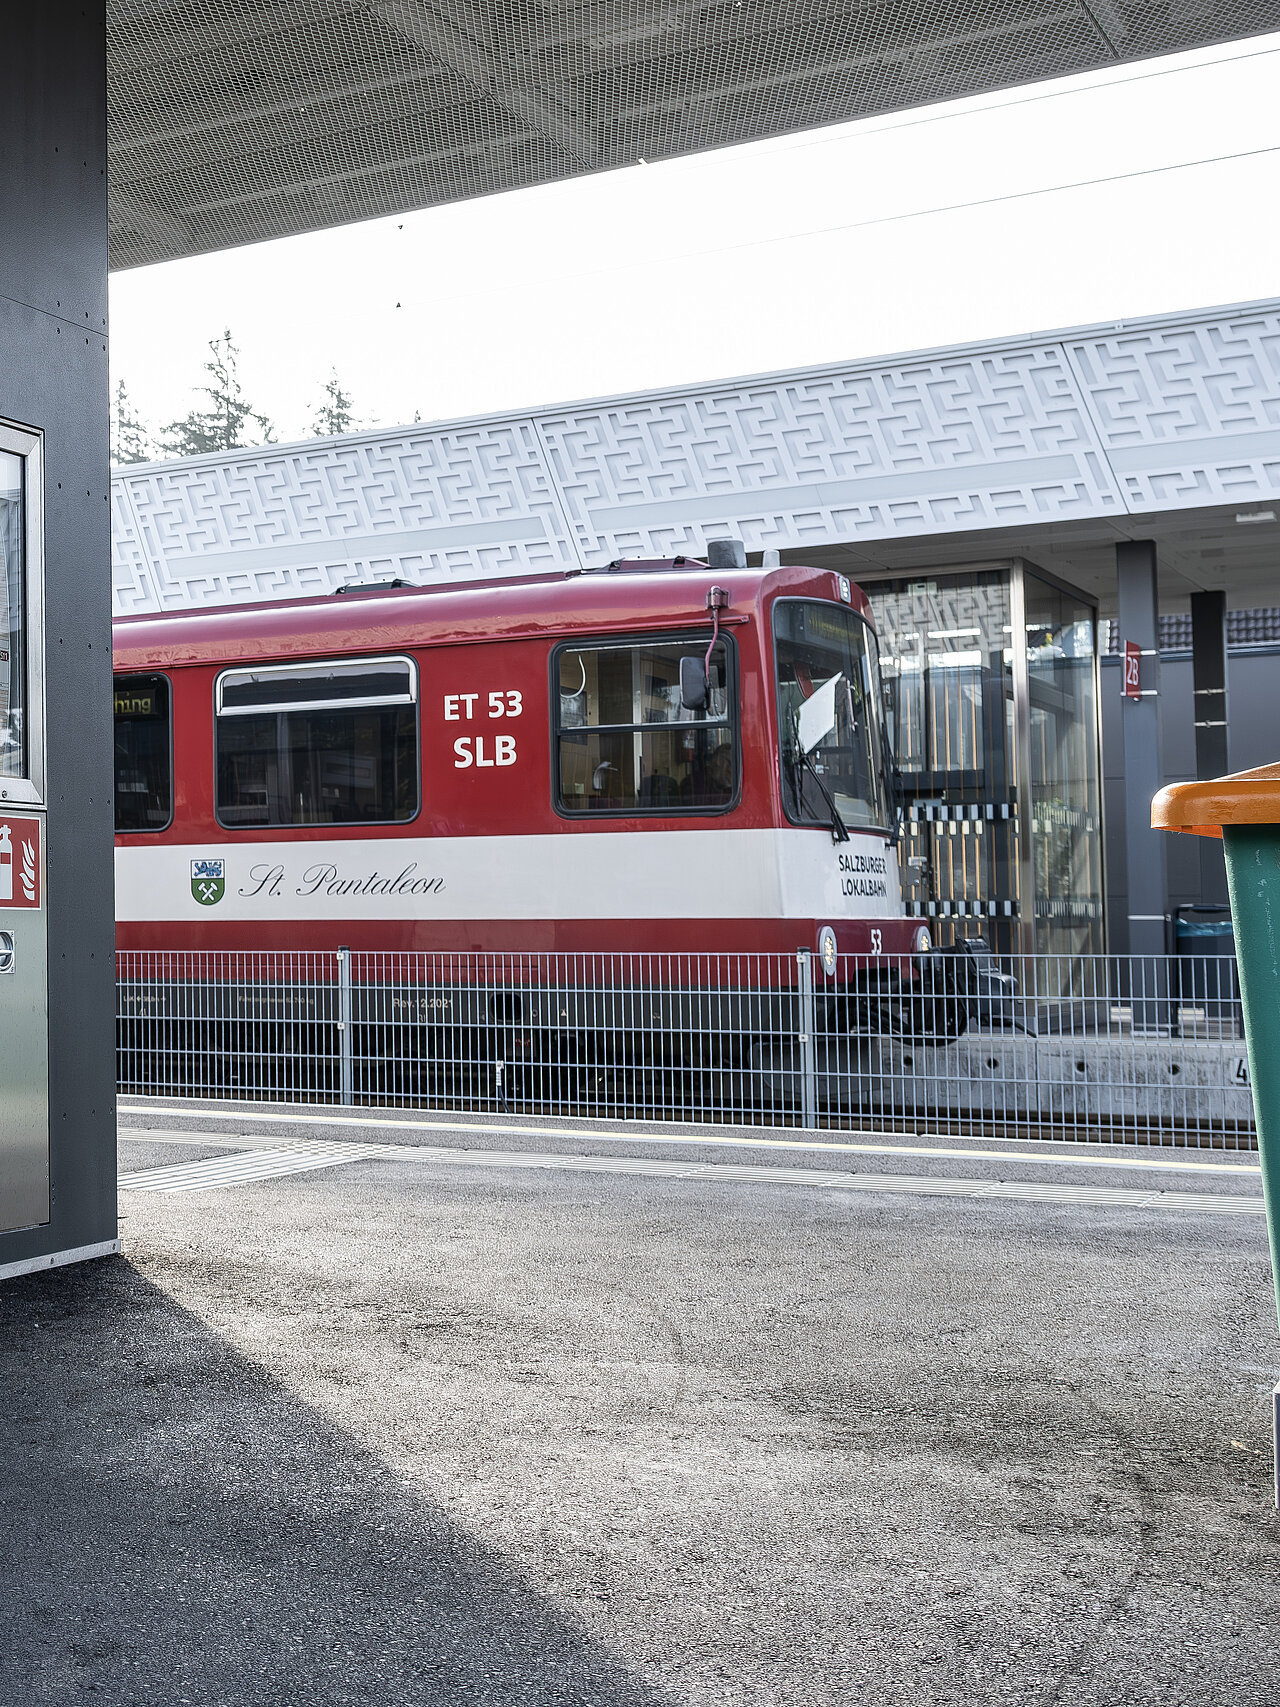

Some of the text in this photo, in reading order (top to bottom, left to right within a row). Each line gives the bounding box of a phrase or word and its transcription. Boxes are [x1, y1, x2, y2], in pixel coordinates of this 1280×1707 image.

[1126, 655, 1140, 686] 2B
[444, 690, 523, 721] ET 53
[453, 734, 518, 769] SLB
[838, 854, 887, 874] SALZBURGER
[237, 861, 447, 898] St. Pantaleon
[840, 878, 887, 898] LOKALBAHN
[870, 928, 882, 955] 53
[1235, 1058, 1248, 1083] 4
